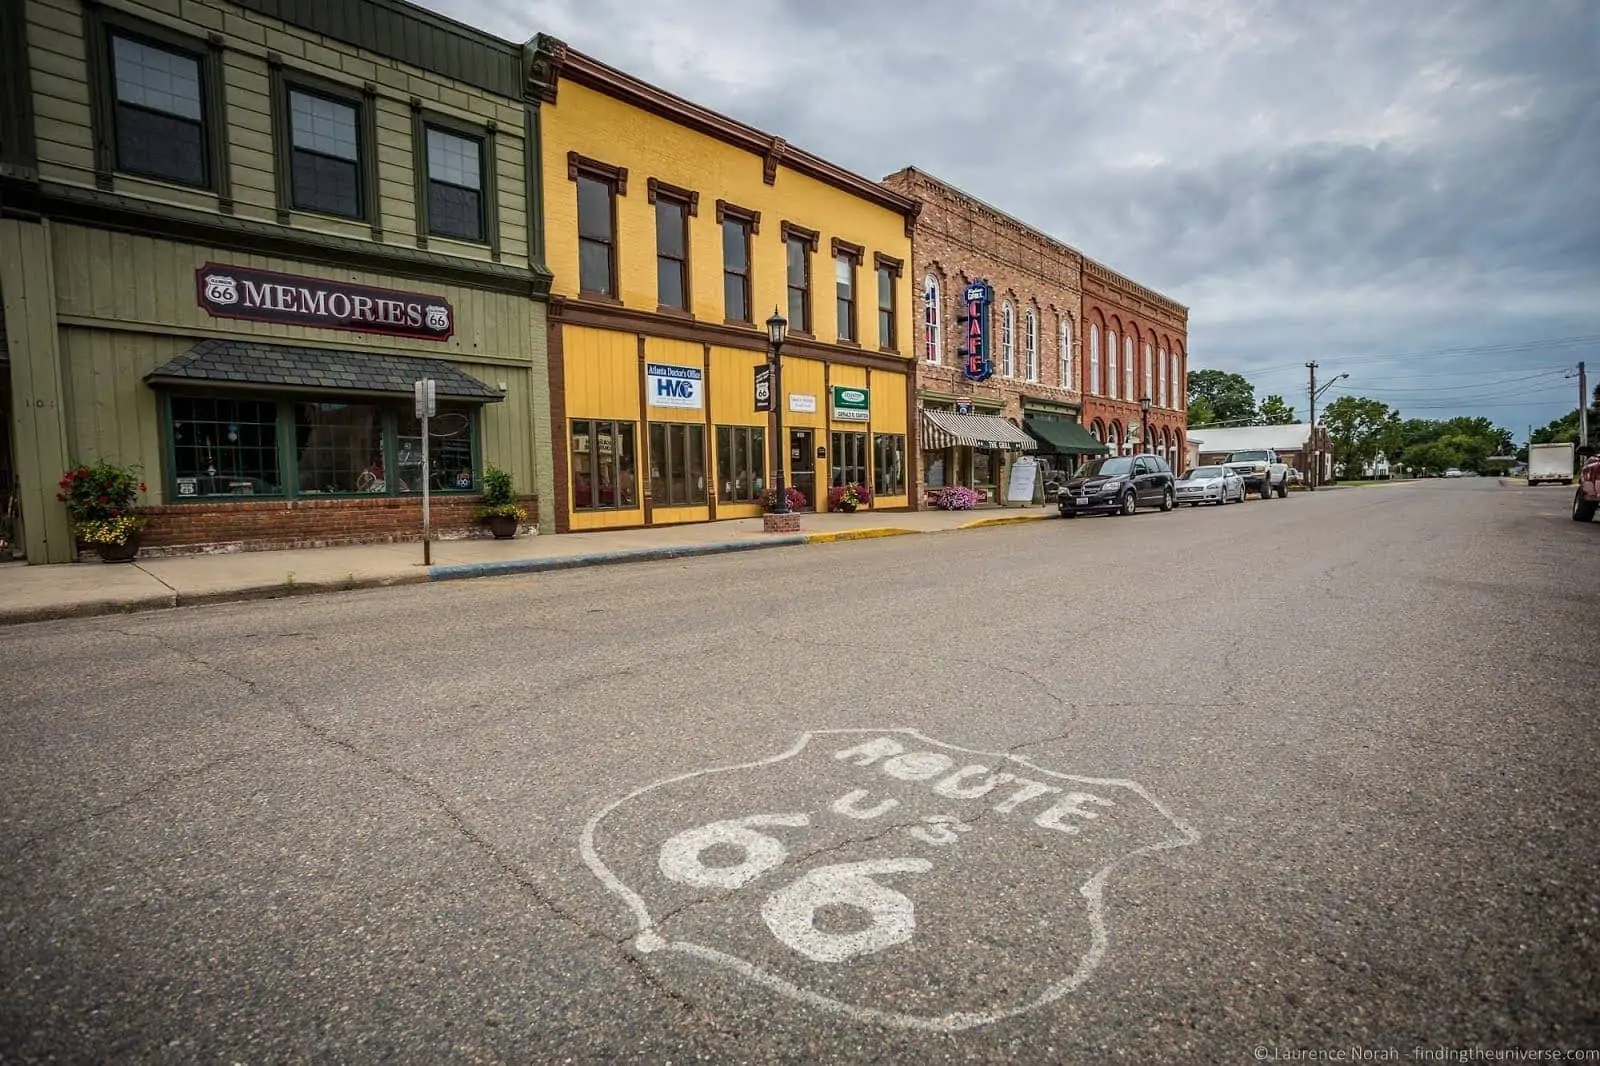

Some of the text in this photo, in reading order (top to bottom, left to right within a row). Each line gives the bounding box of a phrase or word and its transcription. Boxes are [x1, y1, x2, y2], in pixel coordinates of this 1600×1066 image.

[211, 286, 234, 300] 66
[242, 281, 422, 327] MEMORIES
[430, 315, 446, 327] 66
[970, 301, 981, 372] CAFE
[648, 366, 667, 376] Atlanta
[657, 378, 693, 398] HMC
[758, 389, 768, 398] 66
[834, 737, 1115, 834] ROUTE
[659, 814, 933, 962] 66
